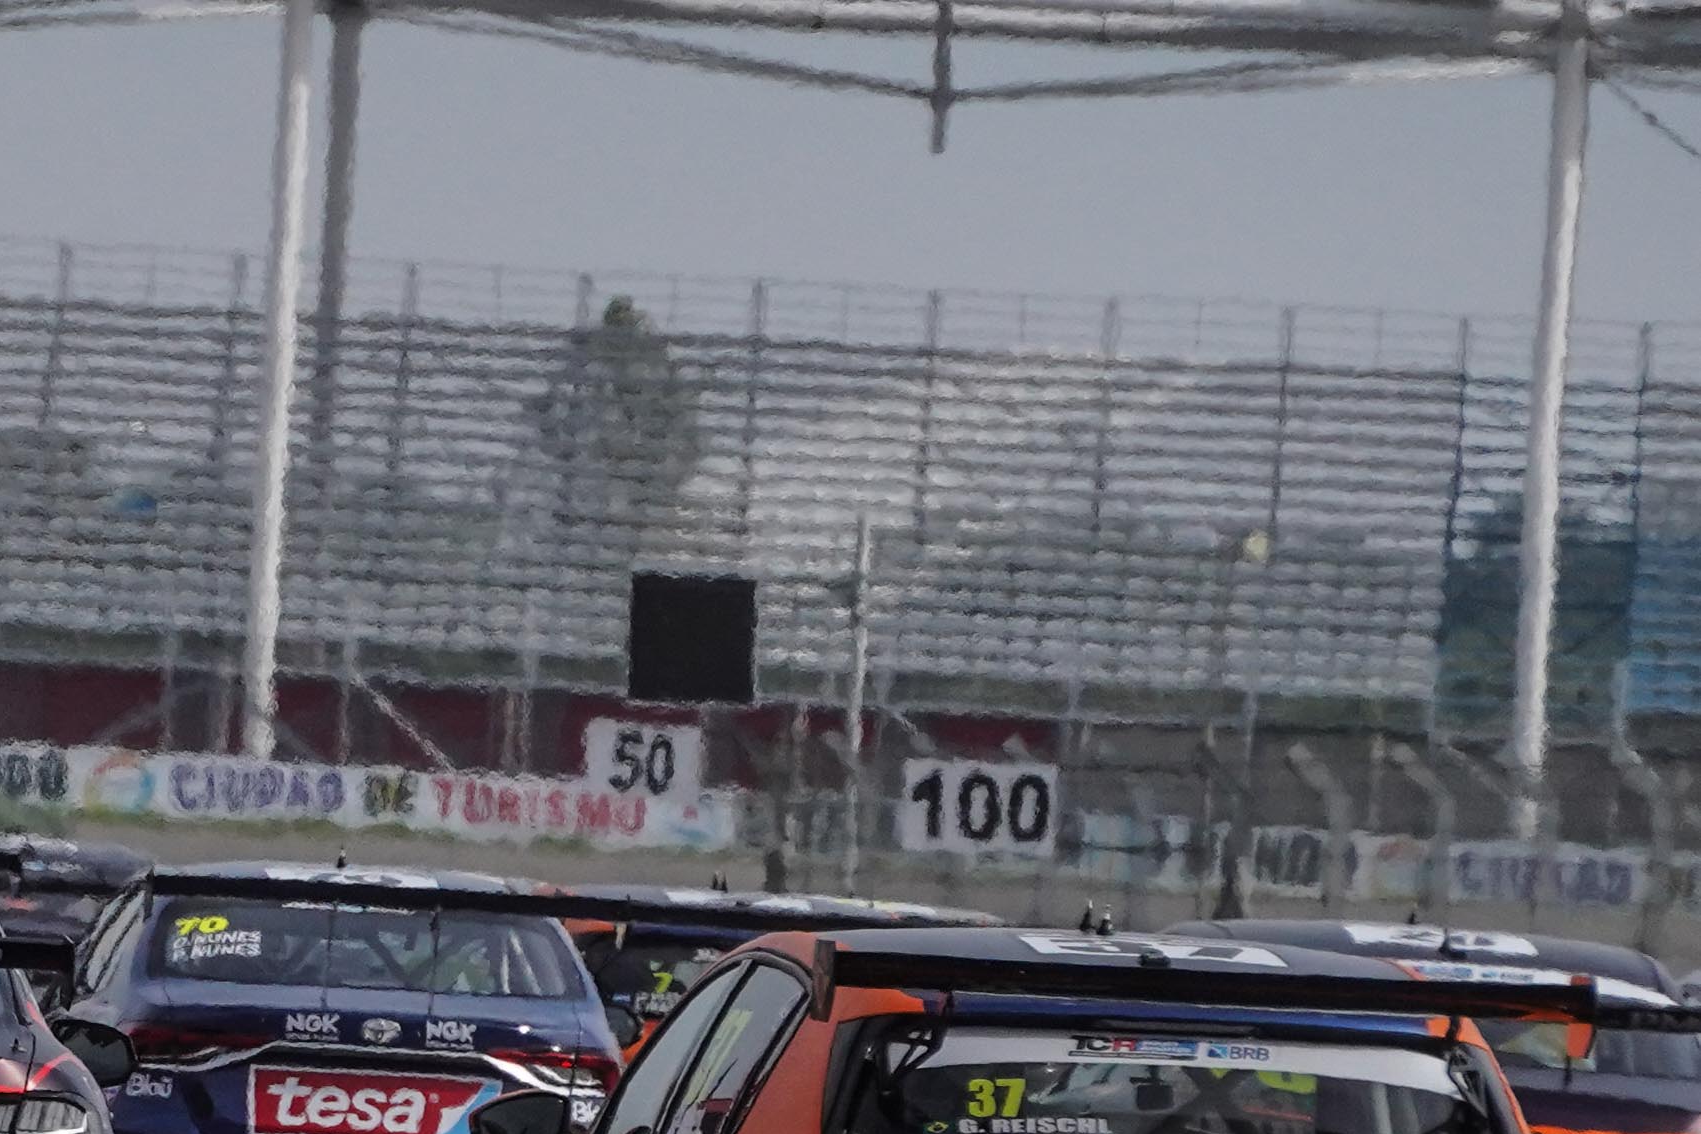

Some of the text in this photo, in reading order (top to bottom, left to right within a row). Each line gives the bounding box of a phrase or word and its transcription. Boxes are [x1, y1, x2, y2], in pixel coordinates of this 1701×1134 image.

[609, 729, 675, 795] 50
[911, 768, 1051, 842] 100
[175, 916, 229, 935] 70
[285, 1012, 341, 1033] NGK
[425, 1019, 478, 1043] NGK
[1070, 1035, 1137, 1051] TCR
[1230, 1046, 1271, 1062] BRB
[267, 1076, 426, 1134] tesa
[968, 1077, 1027, 1118] 37
[957, 1117, 1113, 1134] G. REISCHL
